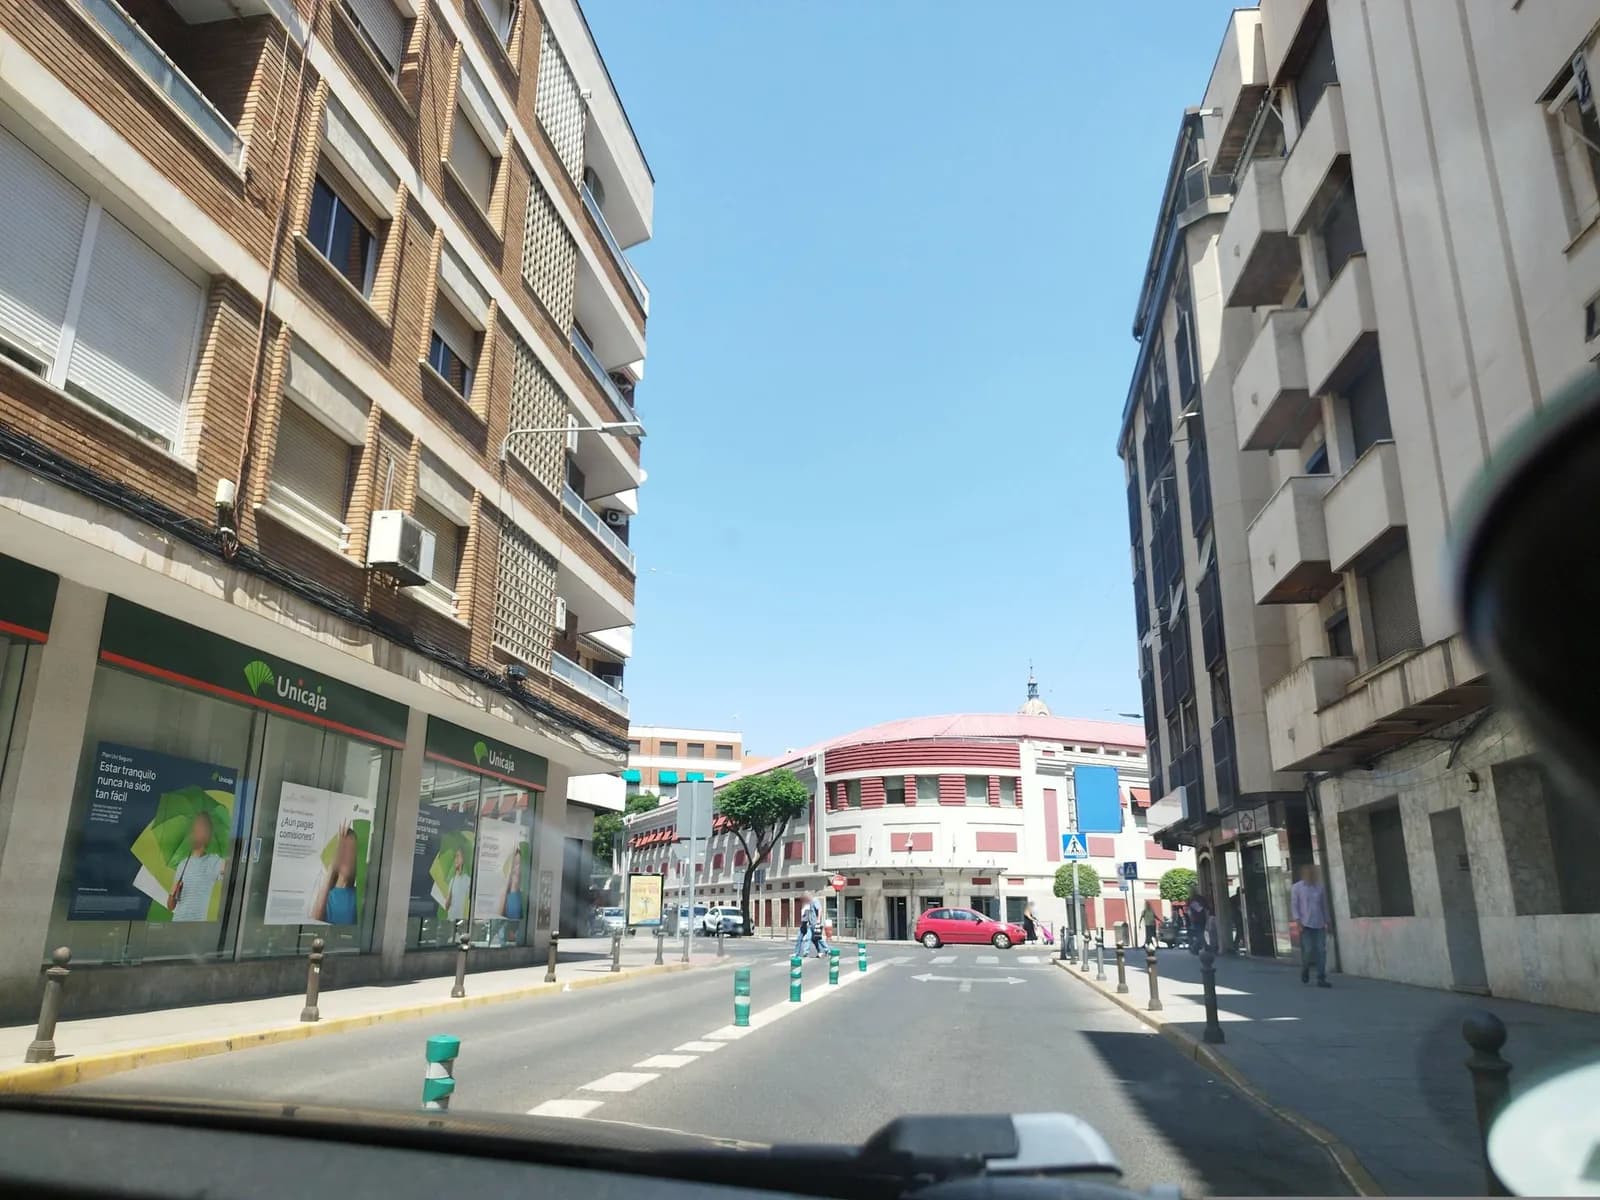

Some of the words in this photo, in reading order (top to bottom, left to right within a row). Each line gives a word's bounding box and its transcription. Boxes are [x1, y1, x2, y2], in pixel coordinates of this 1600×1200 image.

[277, 675, 327, 713] Unicaja
[489, 750, 515, 774] Unicaja
[99, 761, 121, 774] Estar
[122, 766, 157, 781] tranquilo
[97, 776, 123, 788] nunca
[123, 779, 134, 790] ha
[134, 782, 151, 793] sido
[95, 788, 109, 800] tan
[110, 790, 128, 802] fácil
[296, 820, 314, 831] pagas
[279, 830, 315, 841] comisiones?
